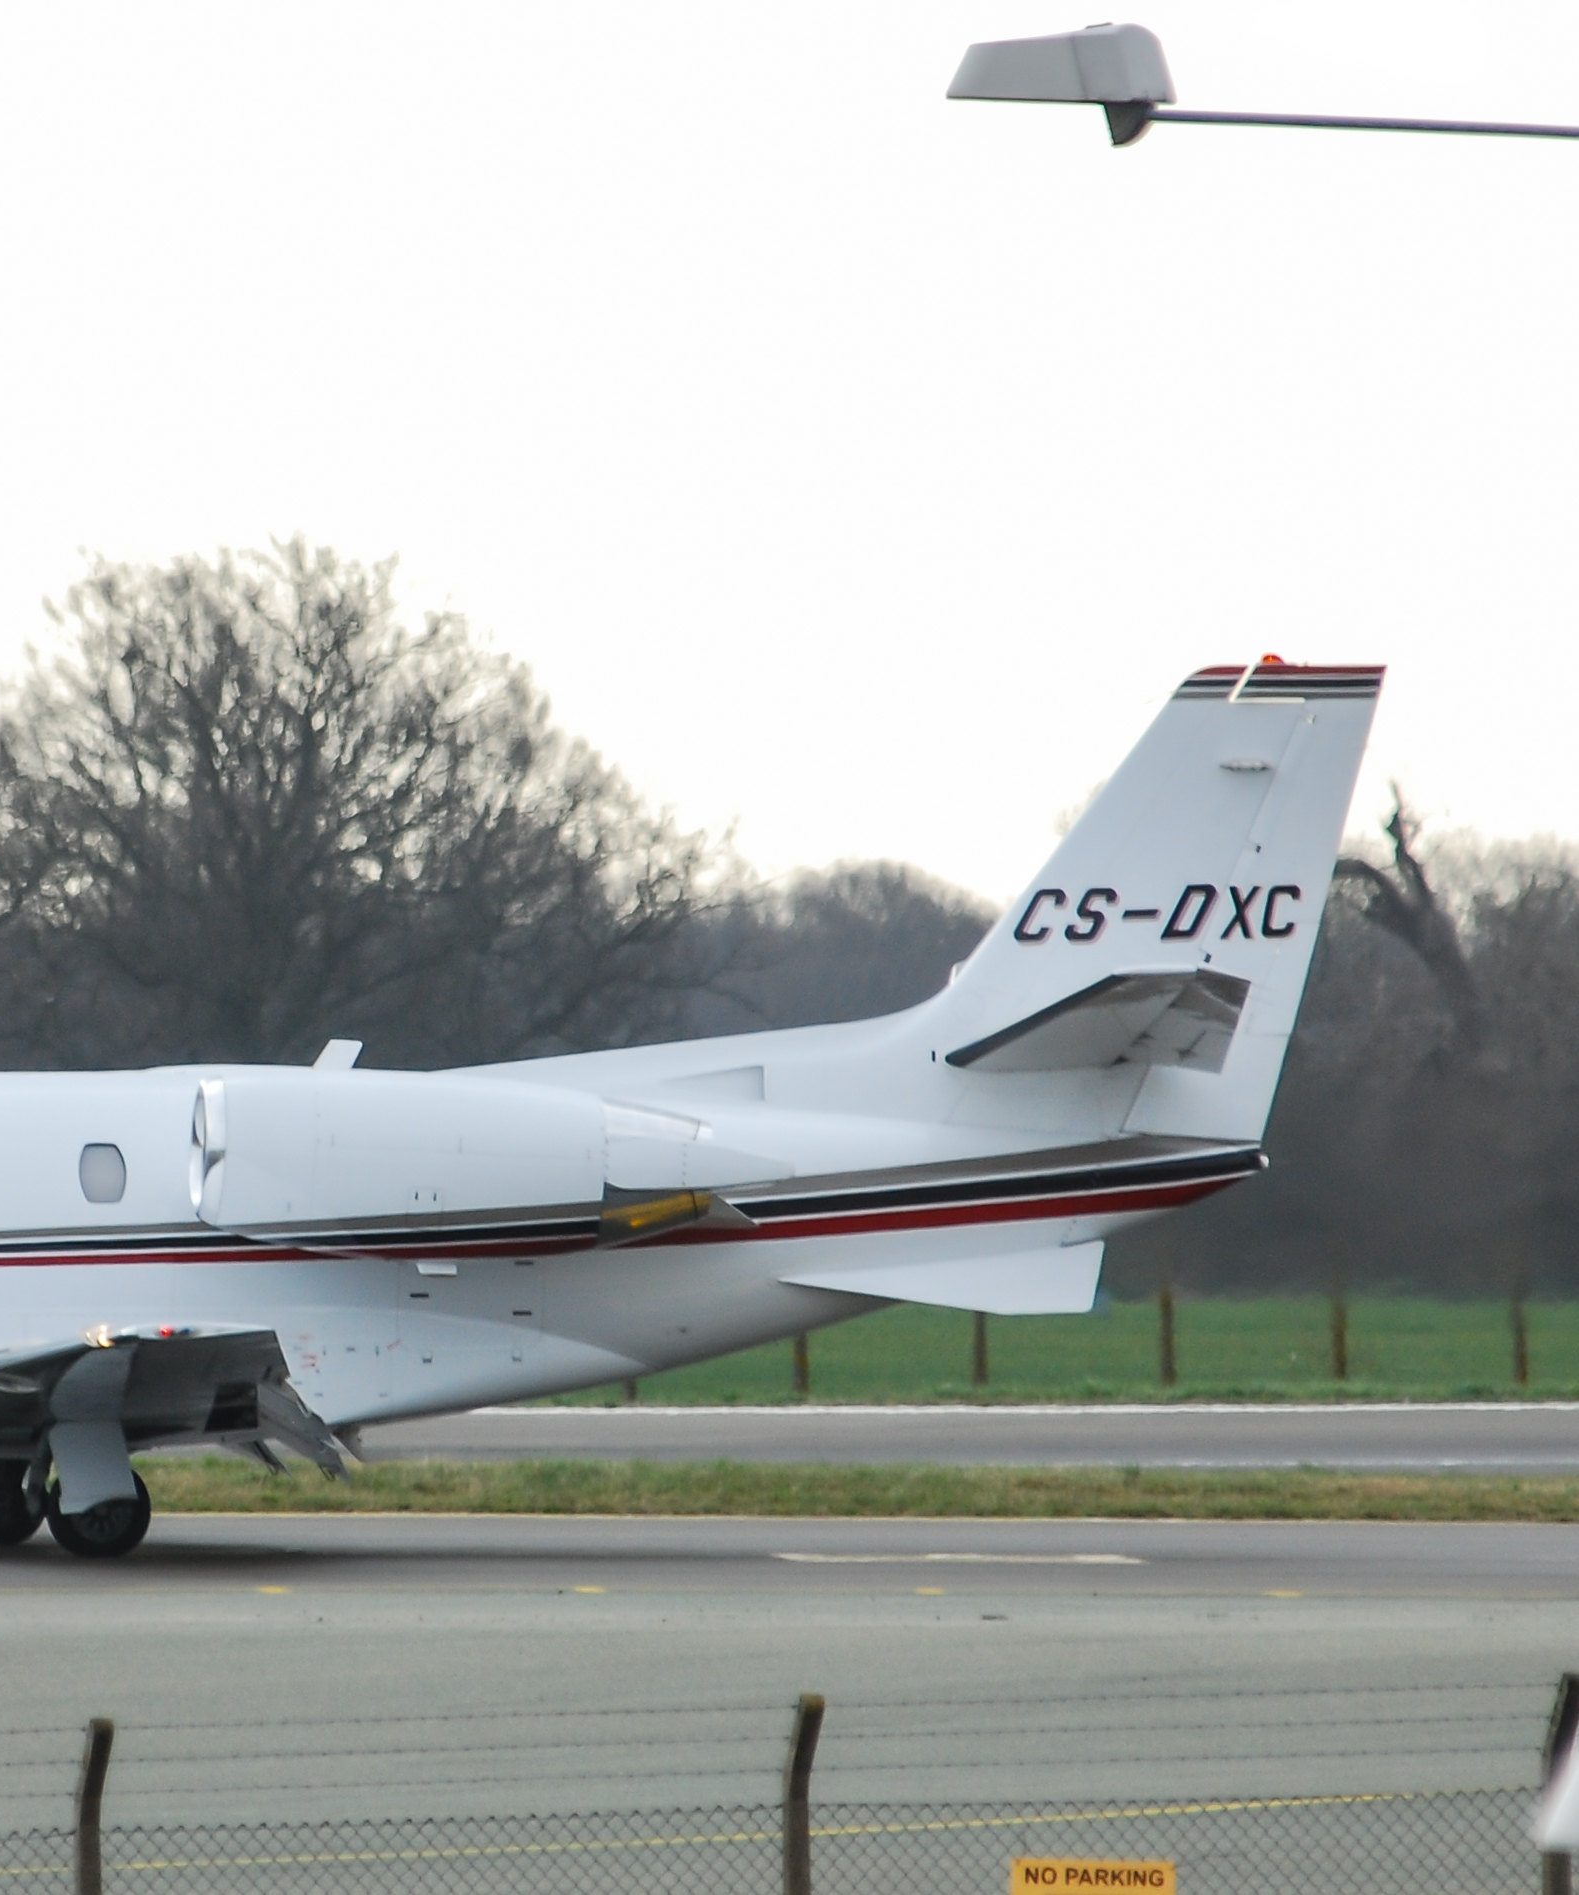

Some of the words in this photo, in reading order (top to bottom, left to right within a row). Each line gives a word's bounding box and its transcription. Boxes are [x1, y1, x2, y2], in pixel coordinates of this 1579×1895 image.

[1013, 884, 1301, 942] CS-DXC
[1024, 1867, 1057, 1885] NO
[1065, 1868, 1165, 1887] PARKING
